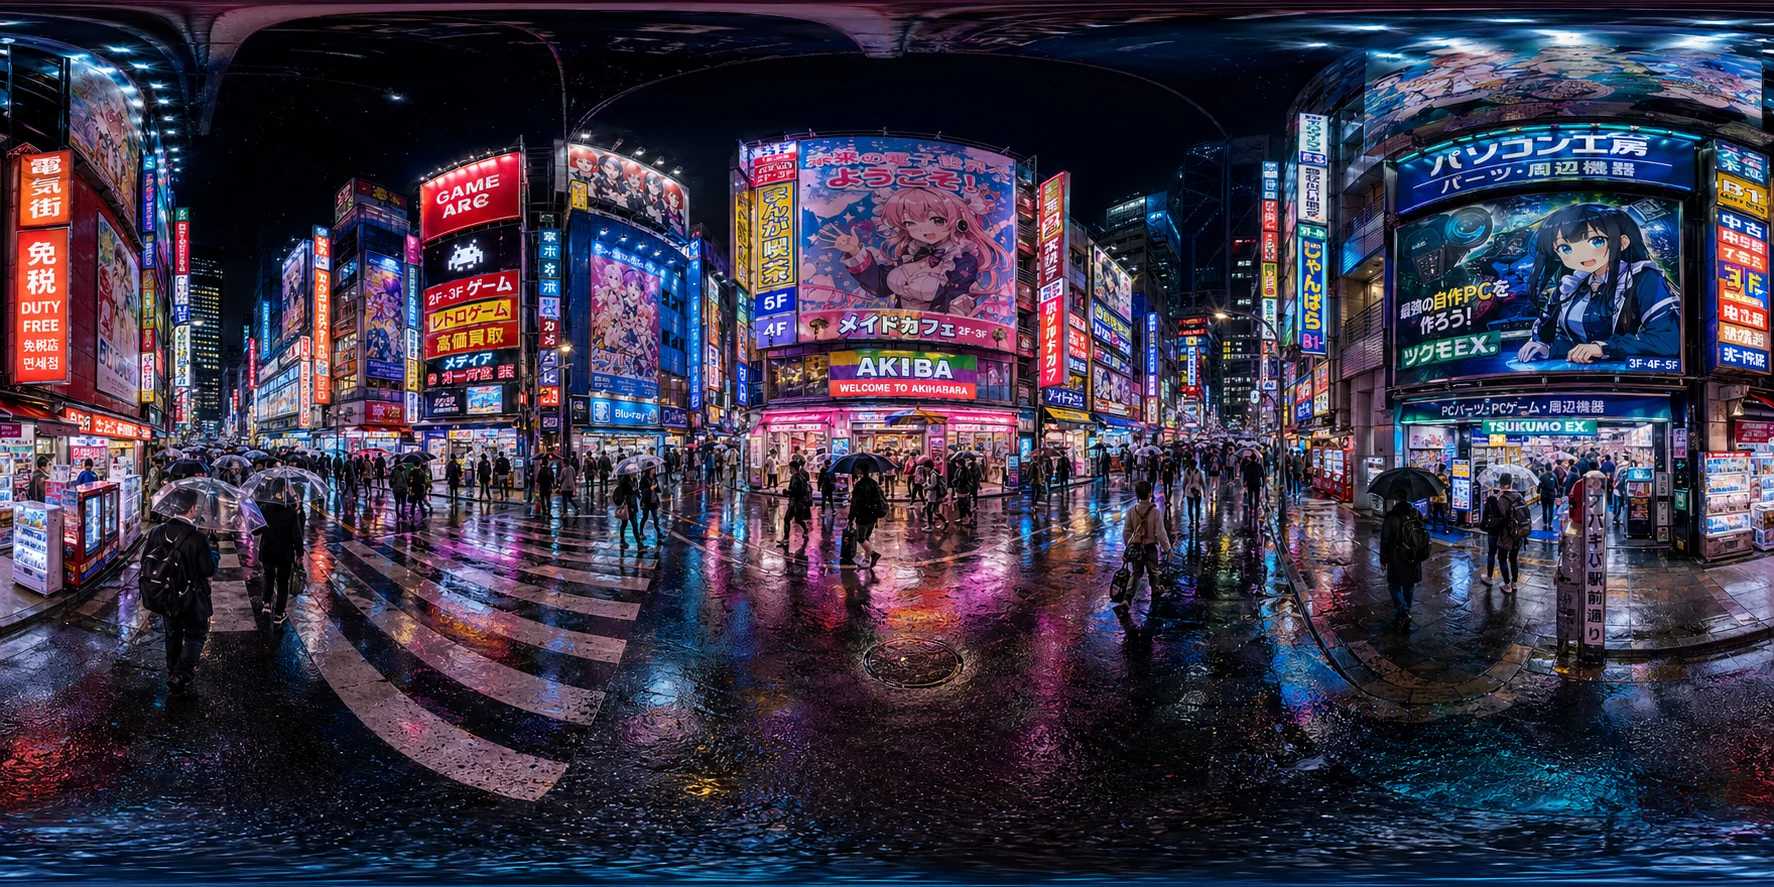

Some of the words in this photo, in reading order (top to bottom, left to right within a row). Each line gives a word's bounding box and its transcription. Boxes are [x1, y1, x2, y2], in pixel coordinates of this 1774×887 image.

[1430, 133, 1649, 177] パソコン工房
[29, 155, 62, 219] 電気街
[436, 173, 500, 205] GAME
[761, 186, 790, 285] まんが喫茶
[1722, 214, 1762, 238] 中古
[27, 241, 57, 295] 免税
[466, 276, 513, 296] ゲーム
[21, 300, 61, 314] DUTY
[764, 293, 788, 311] 5F
[1400, 279, 1510, 320] 最強の自作PCを
[23, 319, 59, 333] FREE
[433, 302, 508, 329] レトロゲーム
[838, 313, 957, 338] メイドカフェ
[1420, 307, 1472, 335] 作ろう!
[437, 327, 504, 353] 高価買取
[763, 321, 788, 337] 4F
[23, 338, 59, 352] 免税店
[1302, 333, 1319, 349] B1
[1404, 335, 1496, 366] ツクモEX.
[23, 356, 58, 370] 면세점
[445, 352, 493, 370] メディア
[856, 356, 954, 379] AKIBA
[840, 383, 890, 393] WELCOME
[894, 383, 908, 393] TO
[1488, 421, 1561, 432] TSUKUMO
[1565, 421, 1589, 432] EX.
